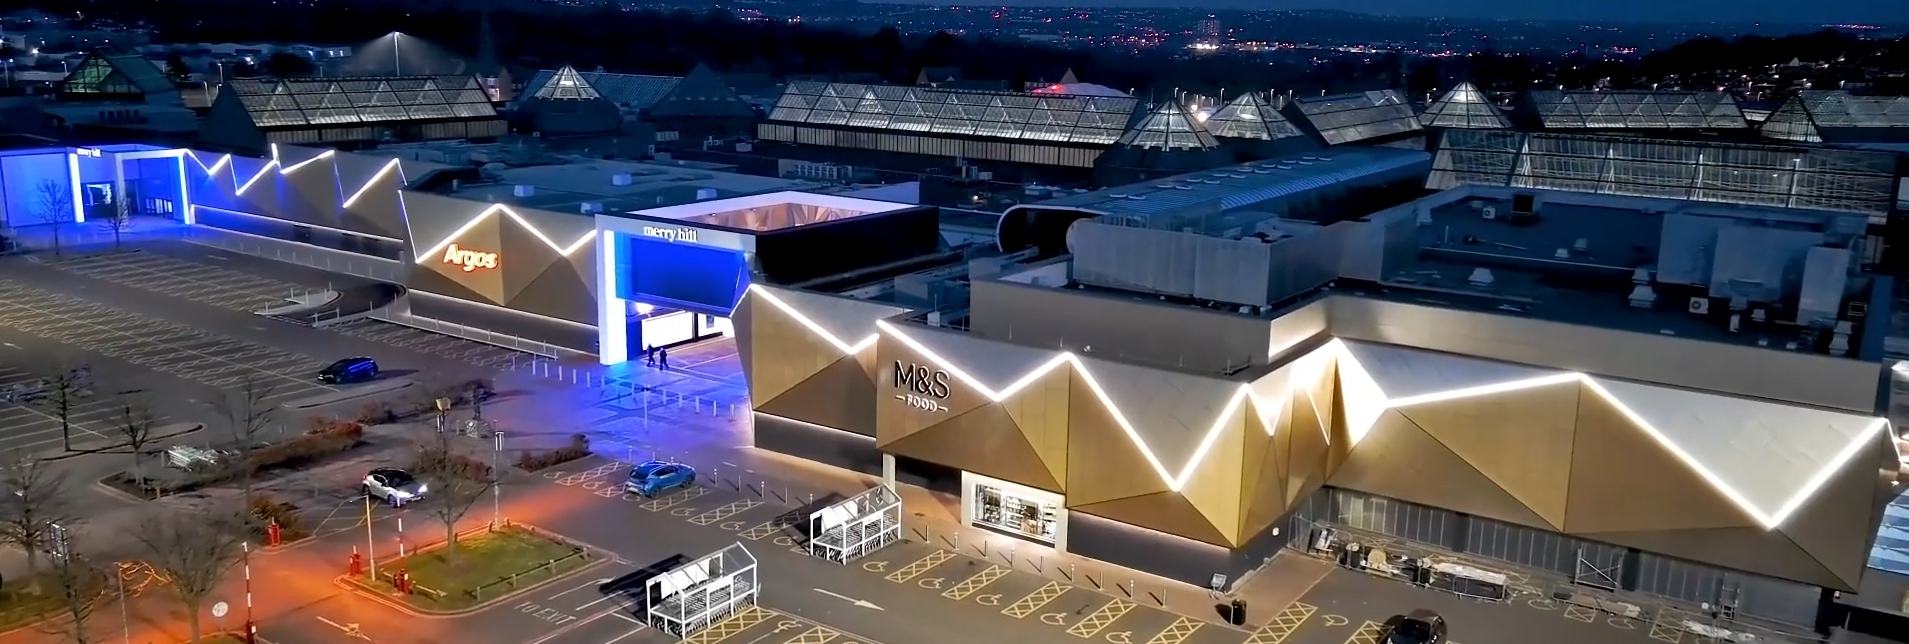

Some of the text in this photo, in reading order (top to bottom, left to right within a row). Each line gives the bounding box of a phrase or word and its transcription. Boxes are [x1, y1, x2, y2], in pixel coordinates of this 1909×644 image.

[643, 226, 697, 244] merry hill
[443, 243, 498, 272] Argos
[895, 360, 950, 400] M&S
